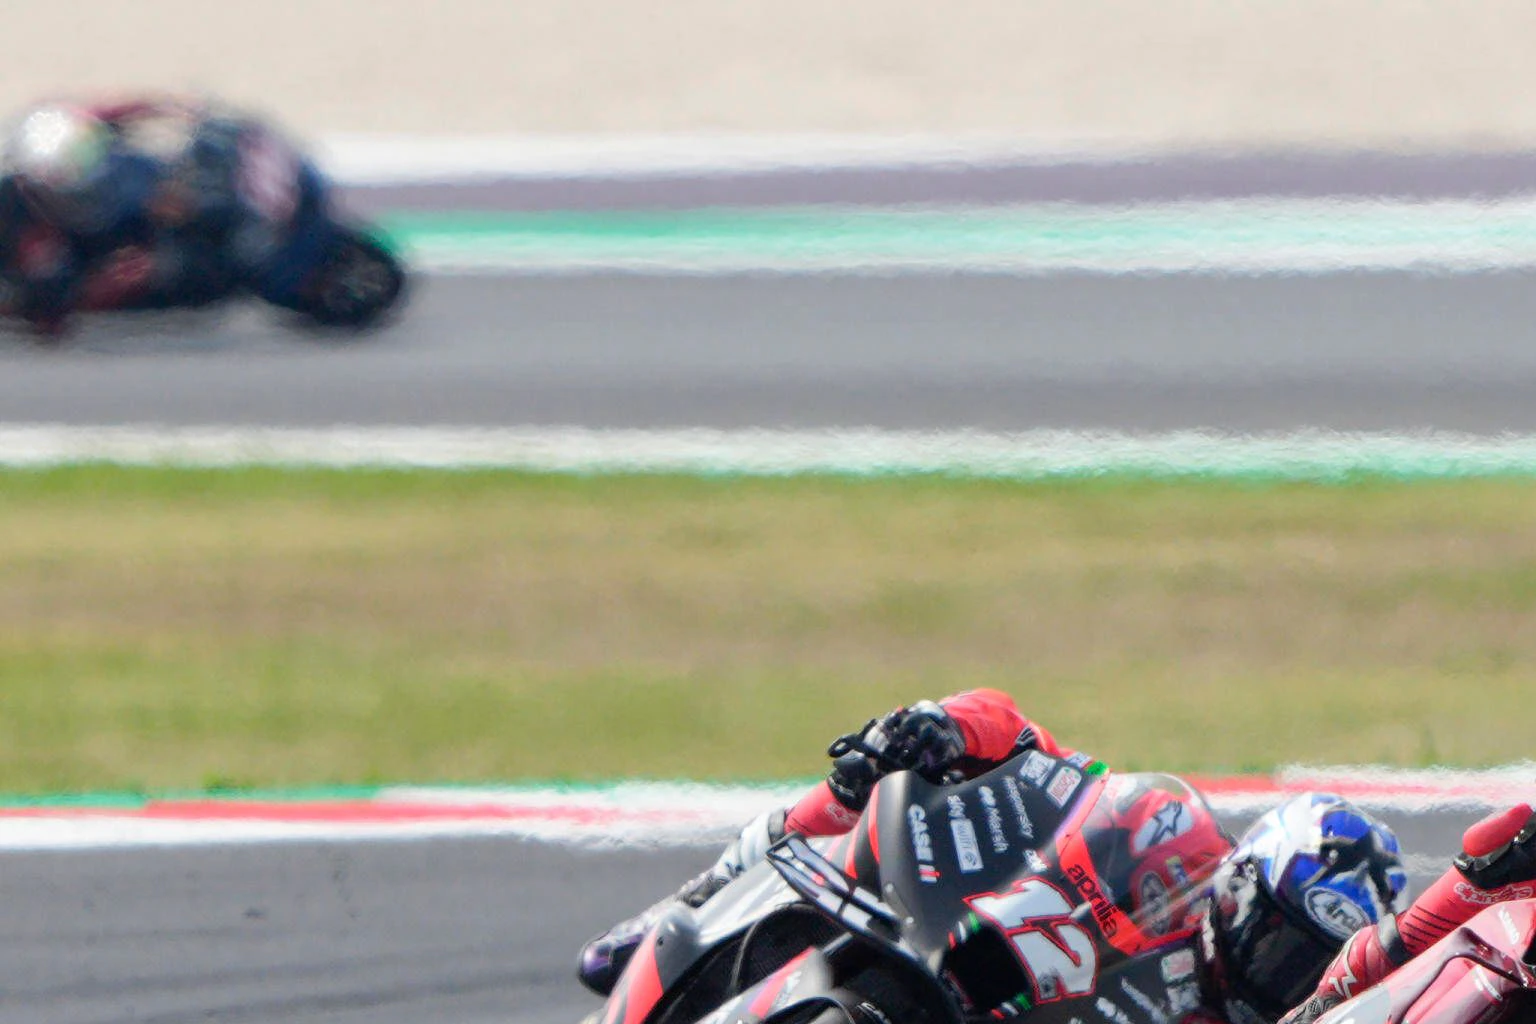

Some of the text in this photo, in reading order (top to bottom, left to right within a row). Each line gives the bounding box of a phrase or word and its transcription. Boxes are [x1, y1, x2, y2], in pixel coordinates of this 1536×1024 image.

[907, 803, 934, 861] CASE
[1067, 864, 1120, 938] aprilia
[962, 875, 1099, 1005] 12
